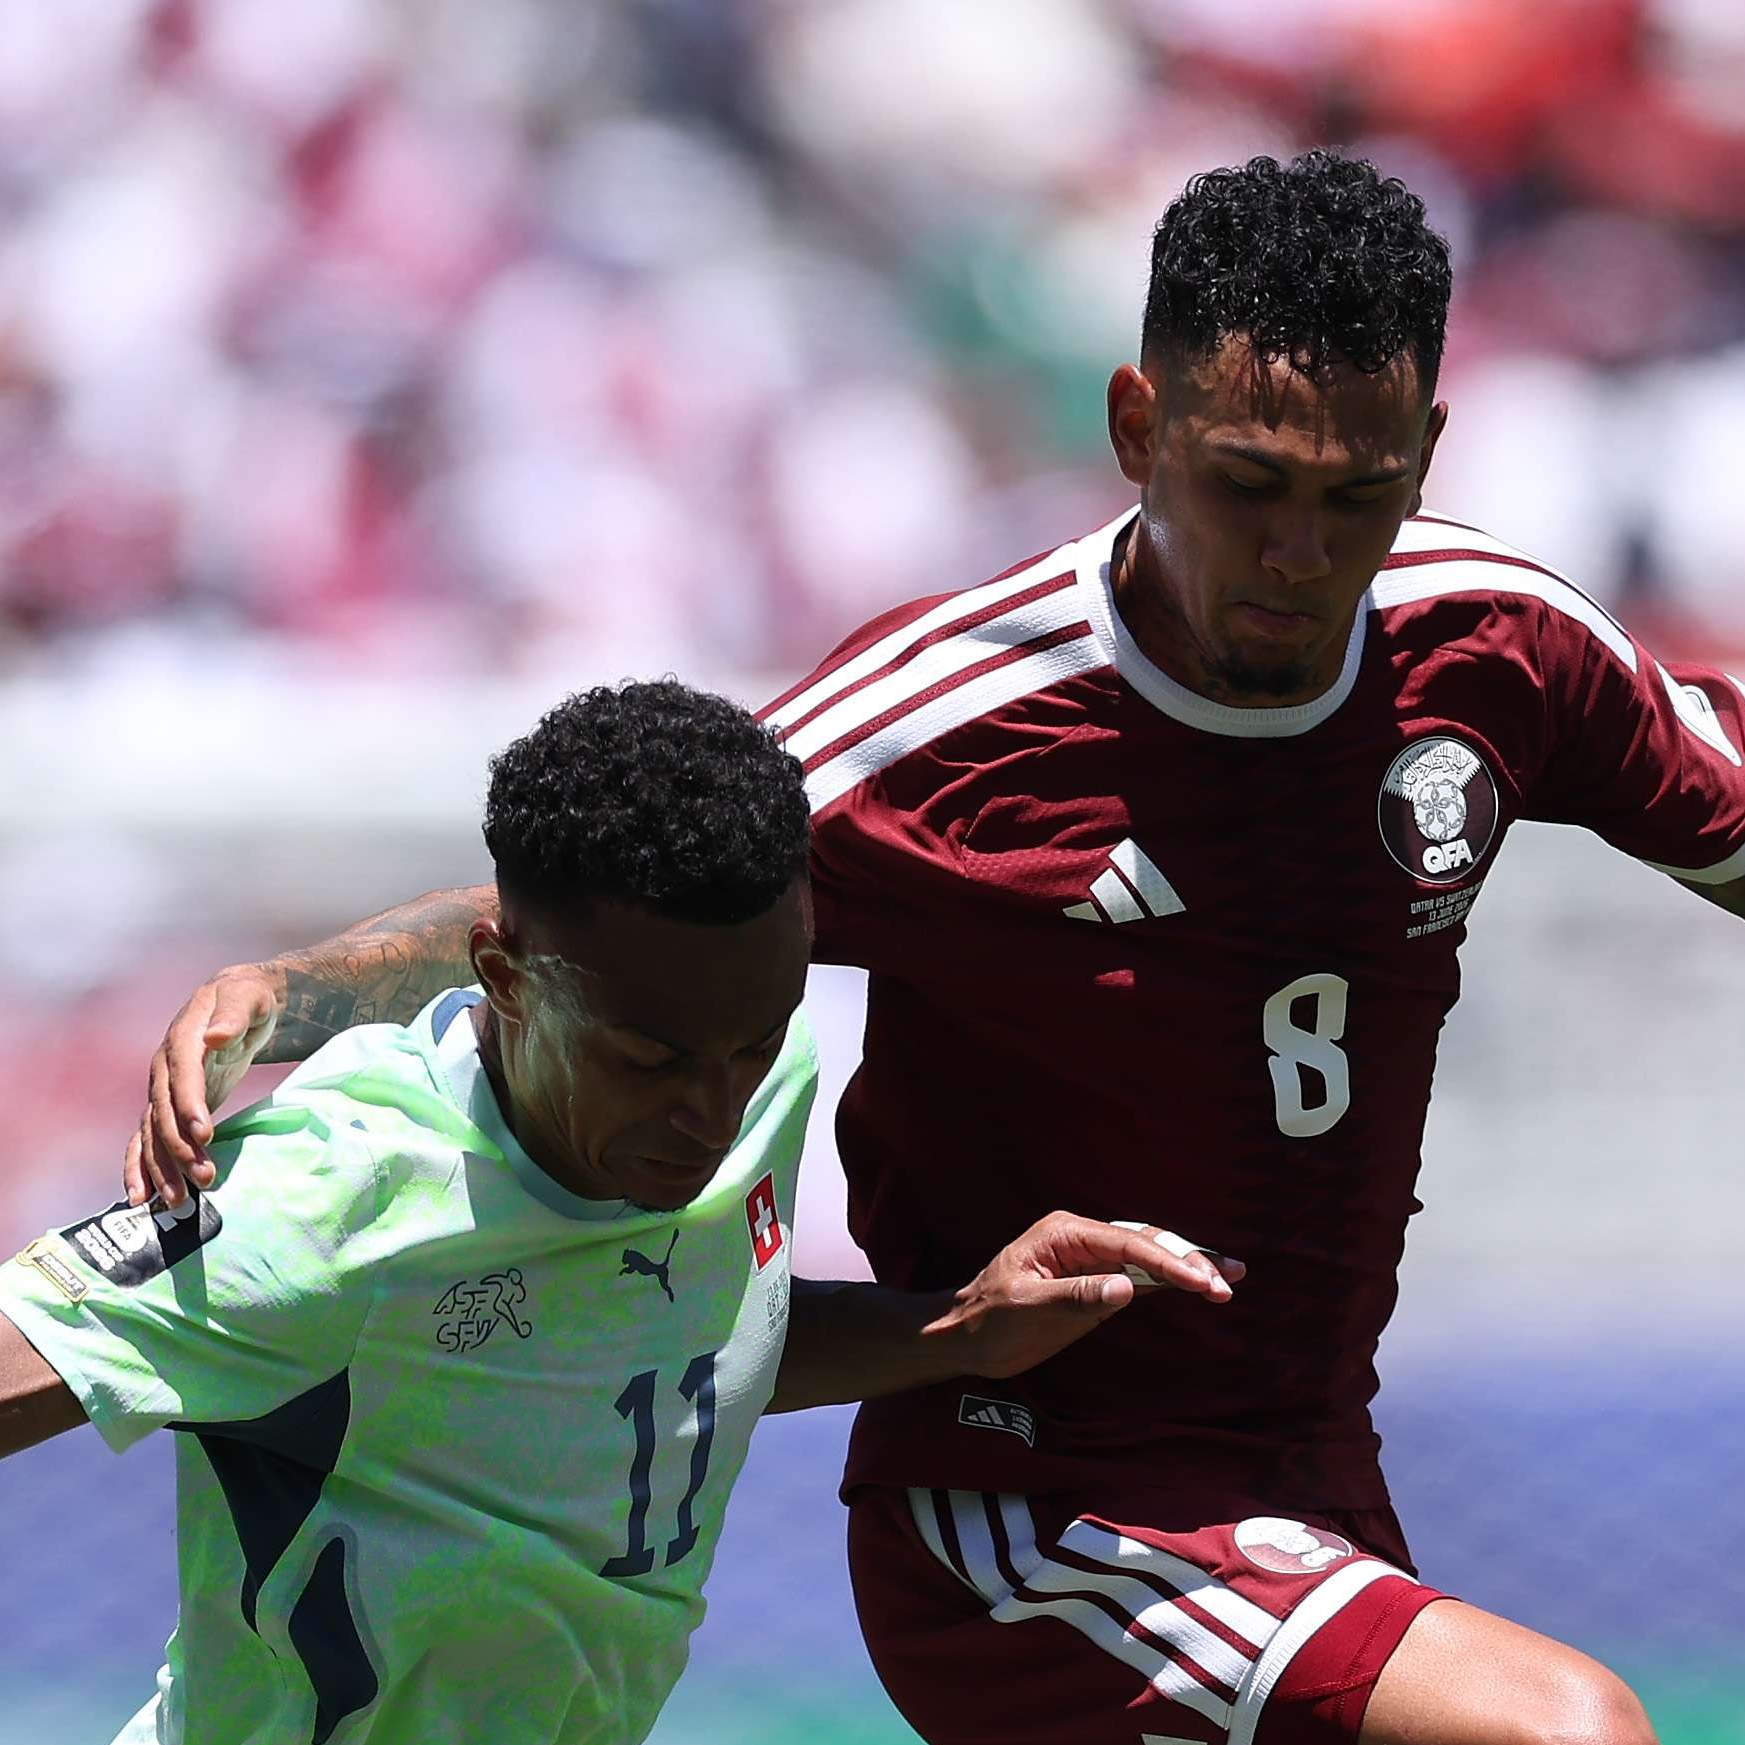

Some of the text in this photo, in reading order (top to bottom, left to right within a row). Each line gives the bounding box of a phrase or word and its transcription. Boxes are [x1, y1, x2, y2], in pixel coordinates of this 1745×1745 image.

[1422, 839, 1473, 874] QFA
[1263, 973, 1349, 1137] 8
[89, 1222, 125, 1262] WORLD CUP
[113, 1219, 132, 1242] FIFA
[598, 1350, 718, 1577] 11
